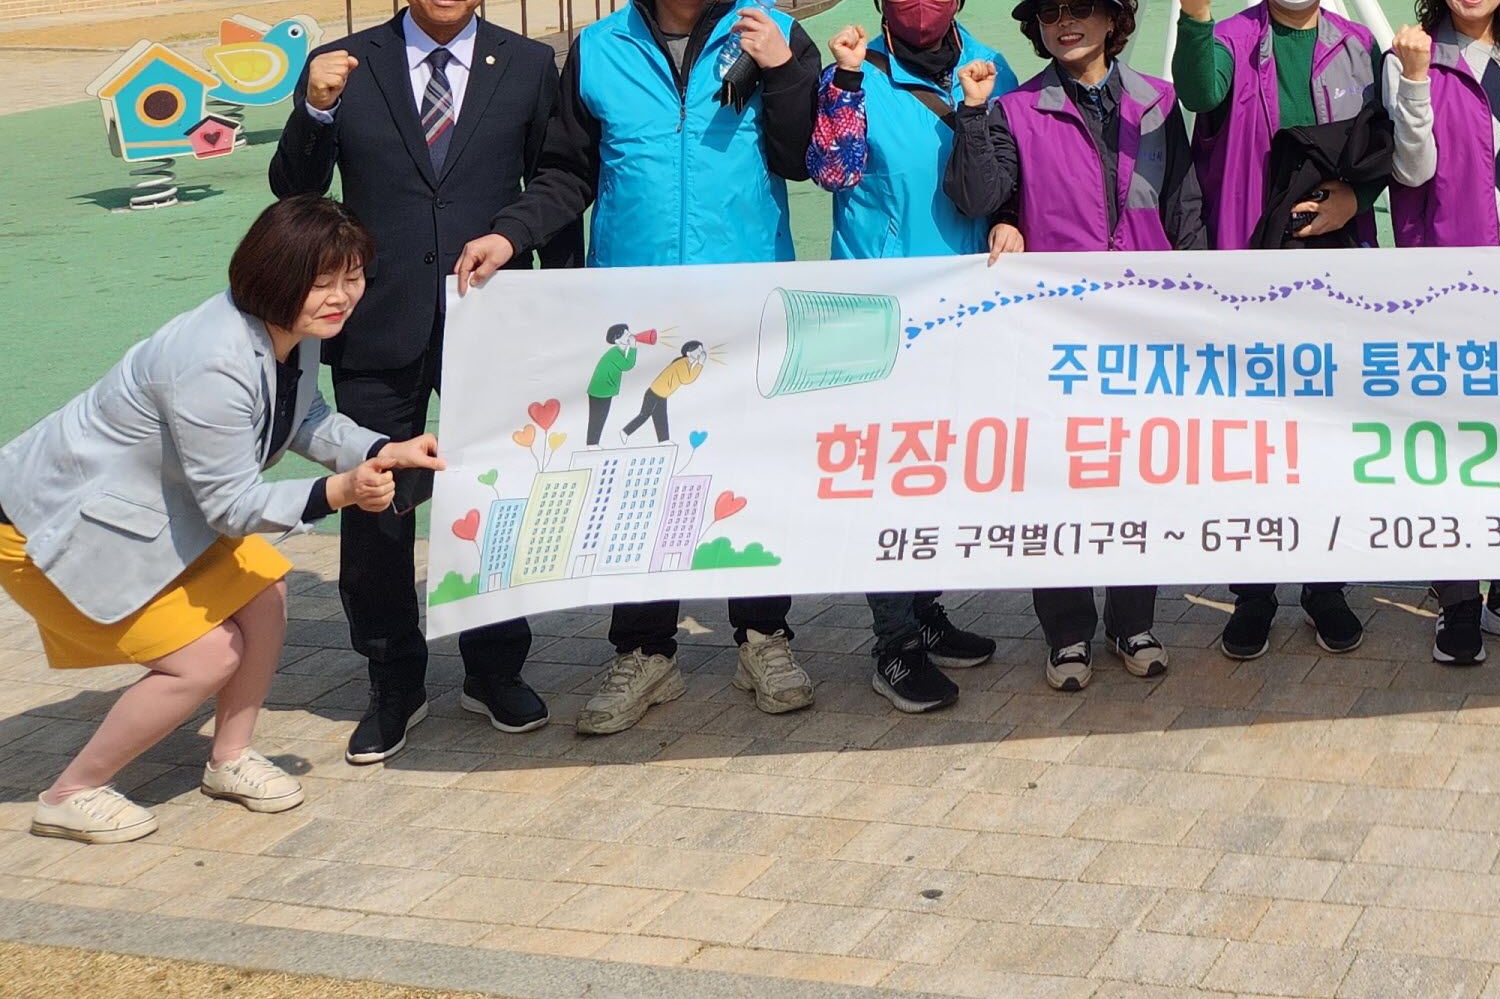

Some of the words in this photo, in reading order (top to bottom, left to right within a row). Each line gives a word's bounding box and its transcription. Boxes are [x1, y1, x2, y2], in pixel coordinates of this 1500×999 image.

[1048, 341, 1338, 397] 주민자치회와
[815, 416, 1028, 500] 현장이
[1064, 416, 1301, 490] 답이다!
[876, 526, 939, 561] 와동
[955, 520, 1148, 558] 구역별(1구역
[1200, 517, 1300, 552] 6구역)
[1368, 516, 1472, 549] 2023.
